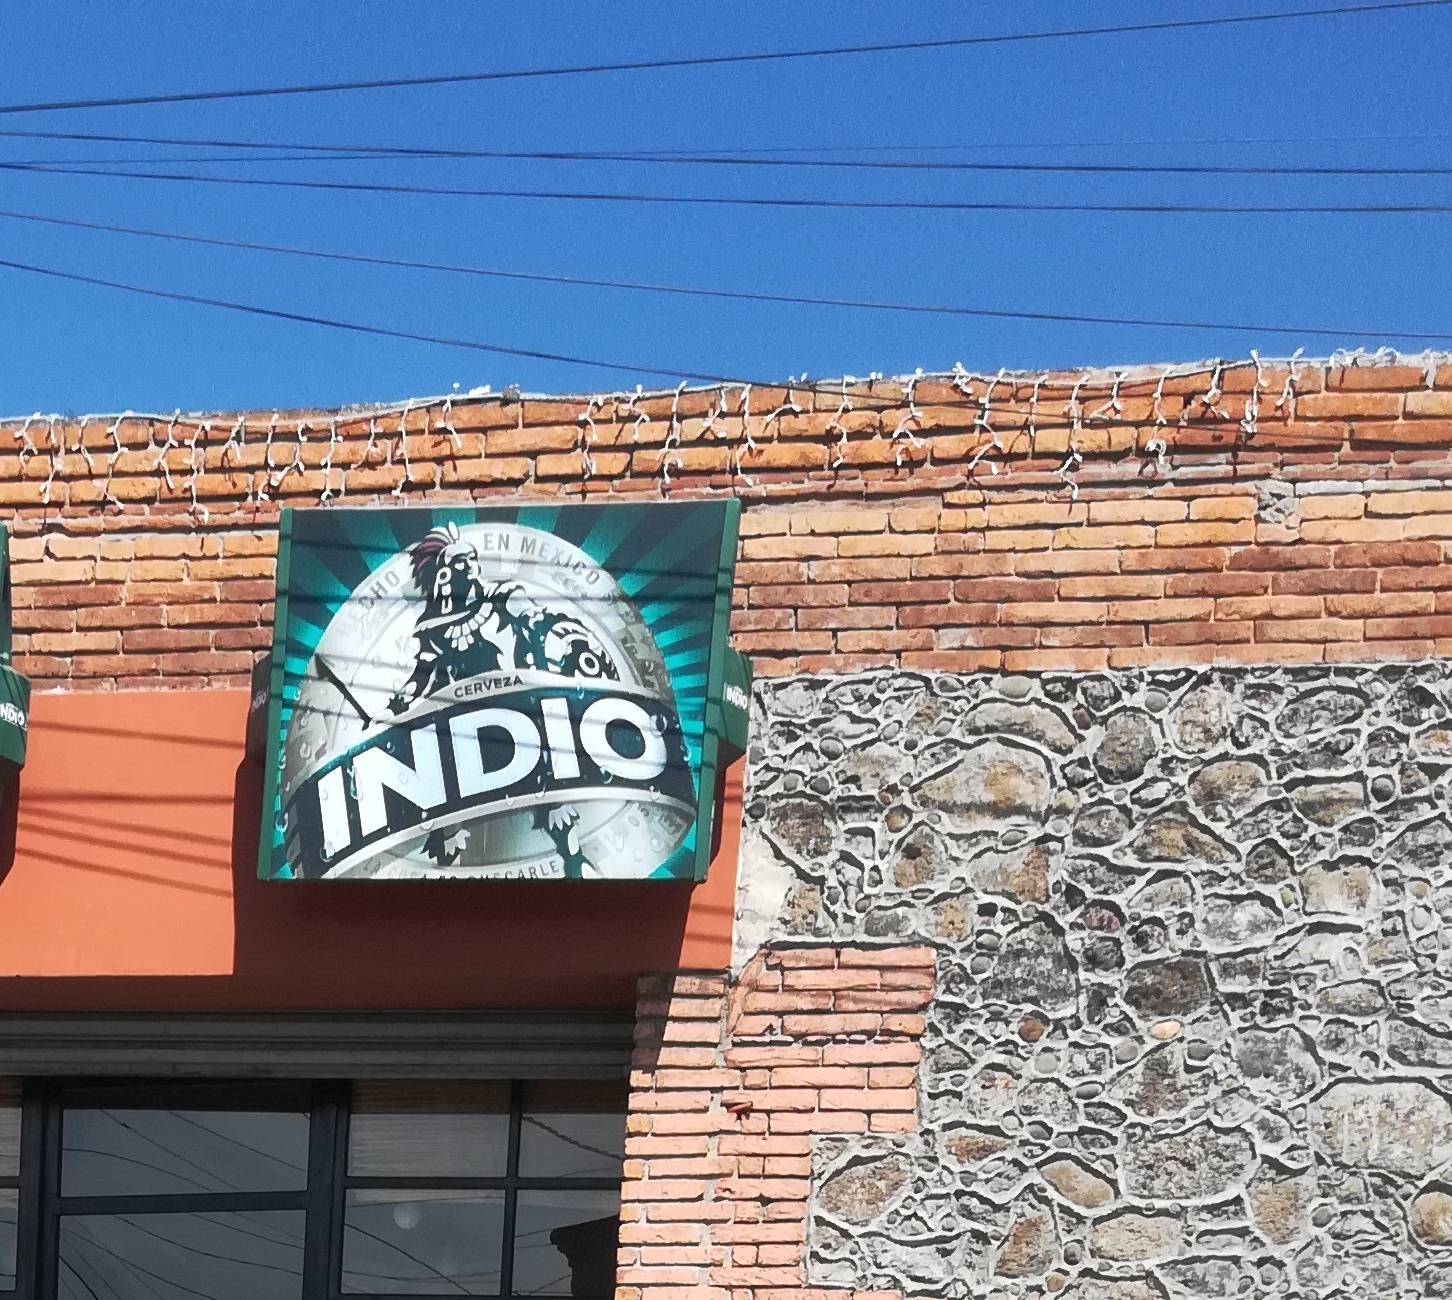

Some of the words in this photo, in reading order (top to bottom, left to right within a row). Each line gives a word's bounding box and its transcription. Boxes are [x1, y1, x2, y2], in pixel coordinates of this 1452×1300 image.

[483, 532, 510, 552] EN
[453, 674, 525, 699] CERVEZA
[317, 696, 668, 858] INDIO
